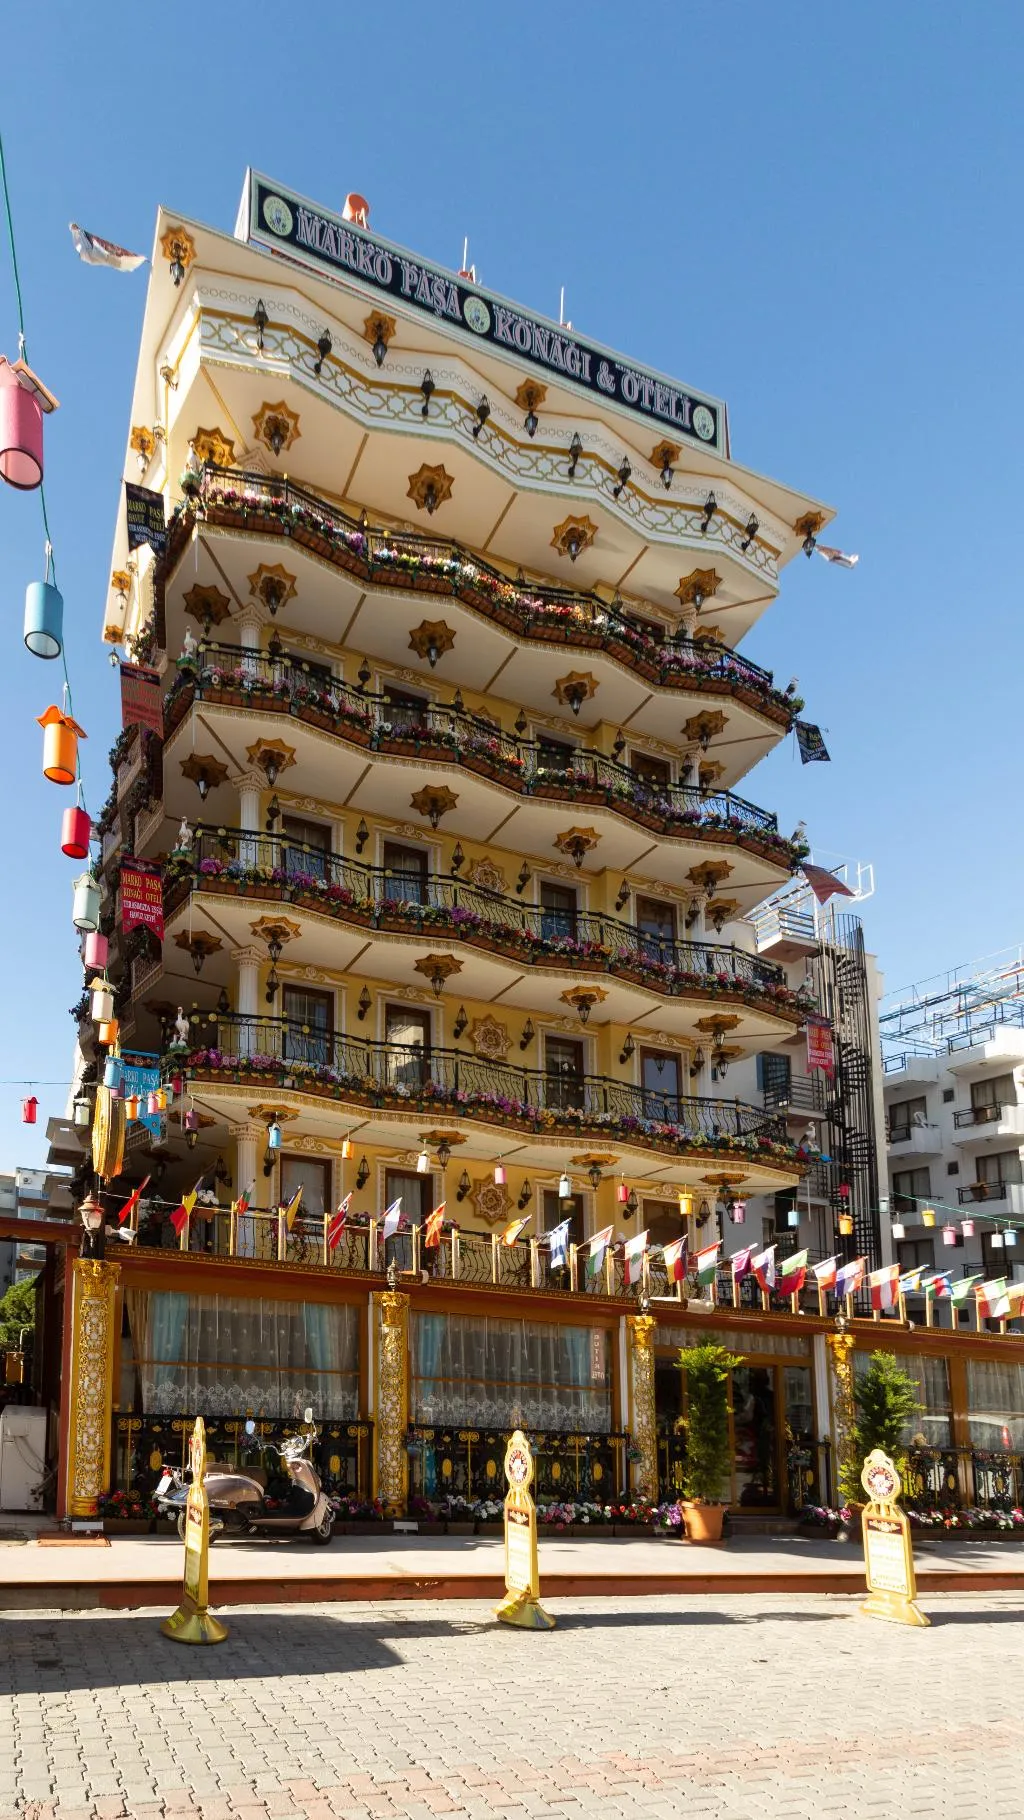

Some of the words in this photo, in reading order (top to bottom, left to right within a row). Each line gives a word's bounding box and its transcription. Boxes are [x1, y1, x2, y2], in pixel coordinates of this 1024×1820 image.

[297, 213, 393, 285] MARKO
[401, 266, 463, 321] PAŞA
[597, 360, 616, 394] &
[145, 877, 163, 891] PAŞA
